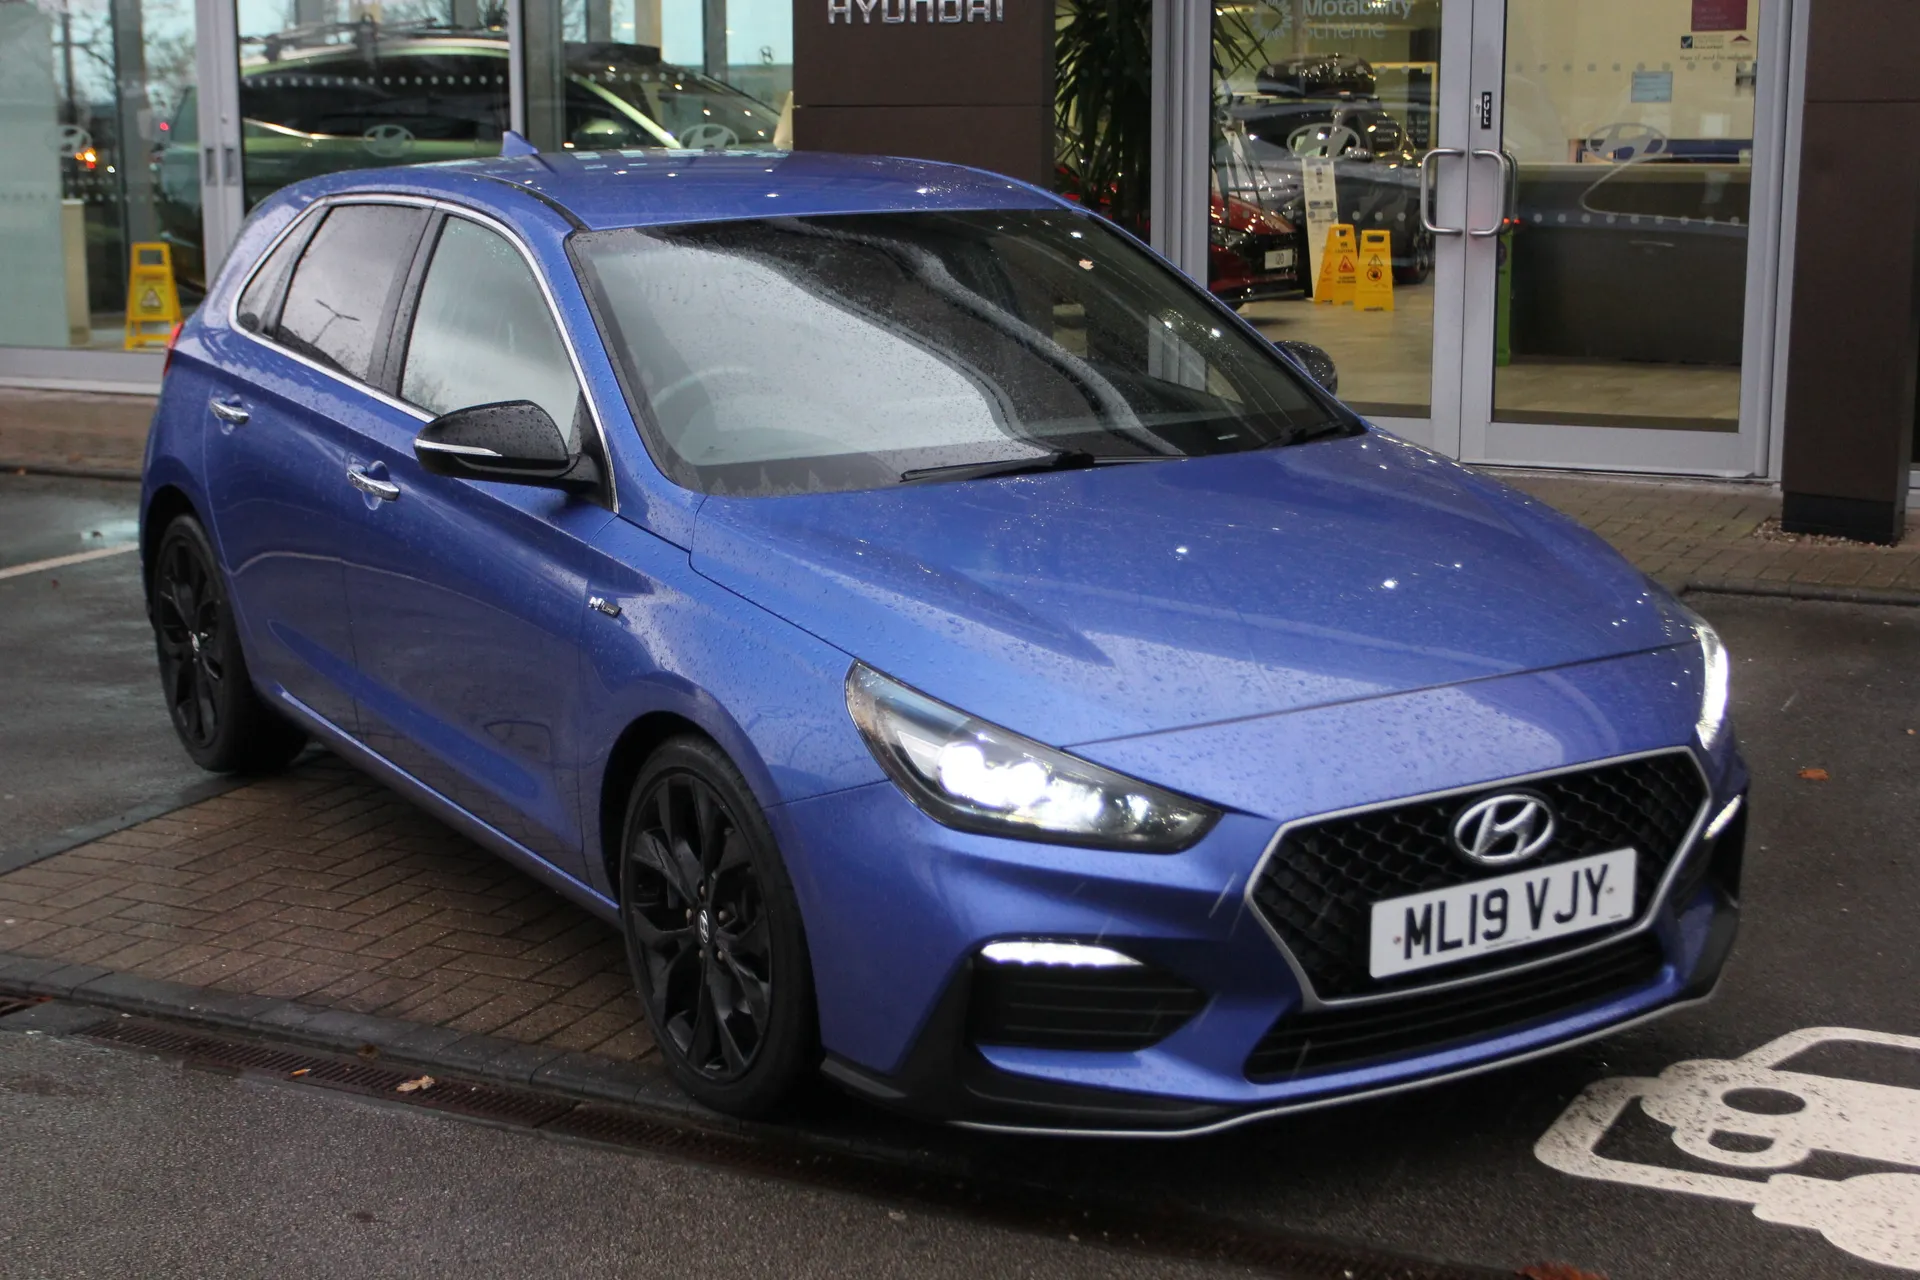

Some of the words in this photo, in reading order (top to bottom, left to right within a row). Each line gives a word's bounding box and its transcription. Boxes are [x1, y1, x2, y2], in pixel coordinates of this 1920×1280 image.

[827, 0, 1004, 24] HYUNDAI
[1302, 0, 1412, 19] Motability
[1301, 20, 1386, 39] Scheme
[1404, 888, 1509, 960] ML19
[1525, 864, 1609, 930] VJY
